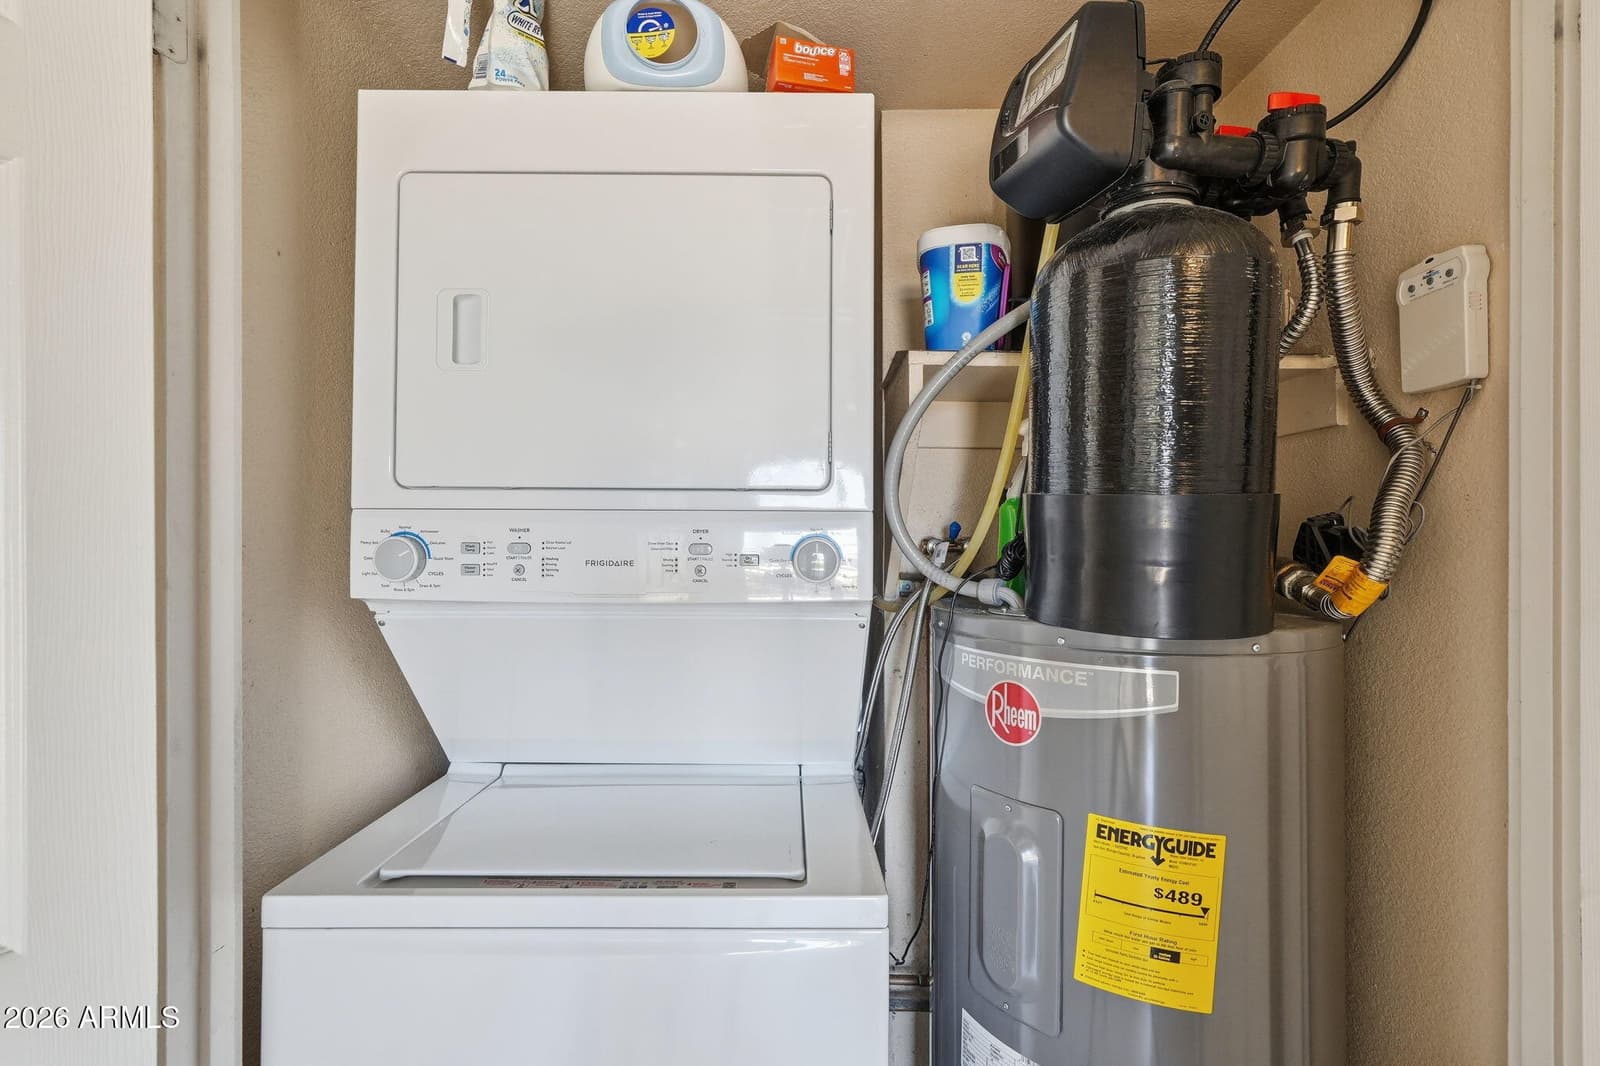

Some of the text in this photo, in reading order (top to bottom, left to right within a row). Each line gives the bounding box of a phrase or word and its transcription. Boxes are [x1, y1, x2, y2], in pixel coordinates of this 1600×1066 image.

[512, 14, 533, 30] WHITE
[794, 42, 835, 56] bounce
[961, 652, 1088, 686] PERFORMANCE
[992, 682, 1037, 734] Rheem
[1096, 823, 1216, 859] ENERGYGUIDE
[1154, 887, 1203, 906] $489
